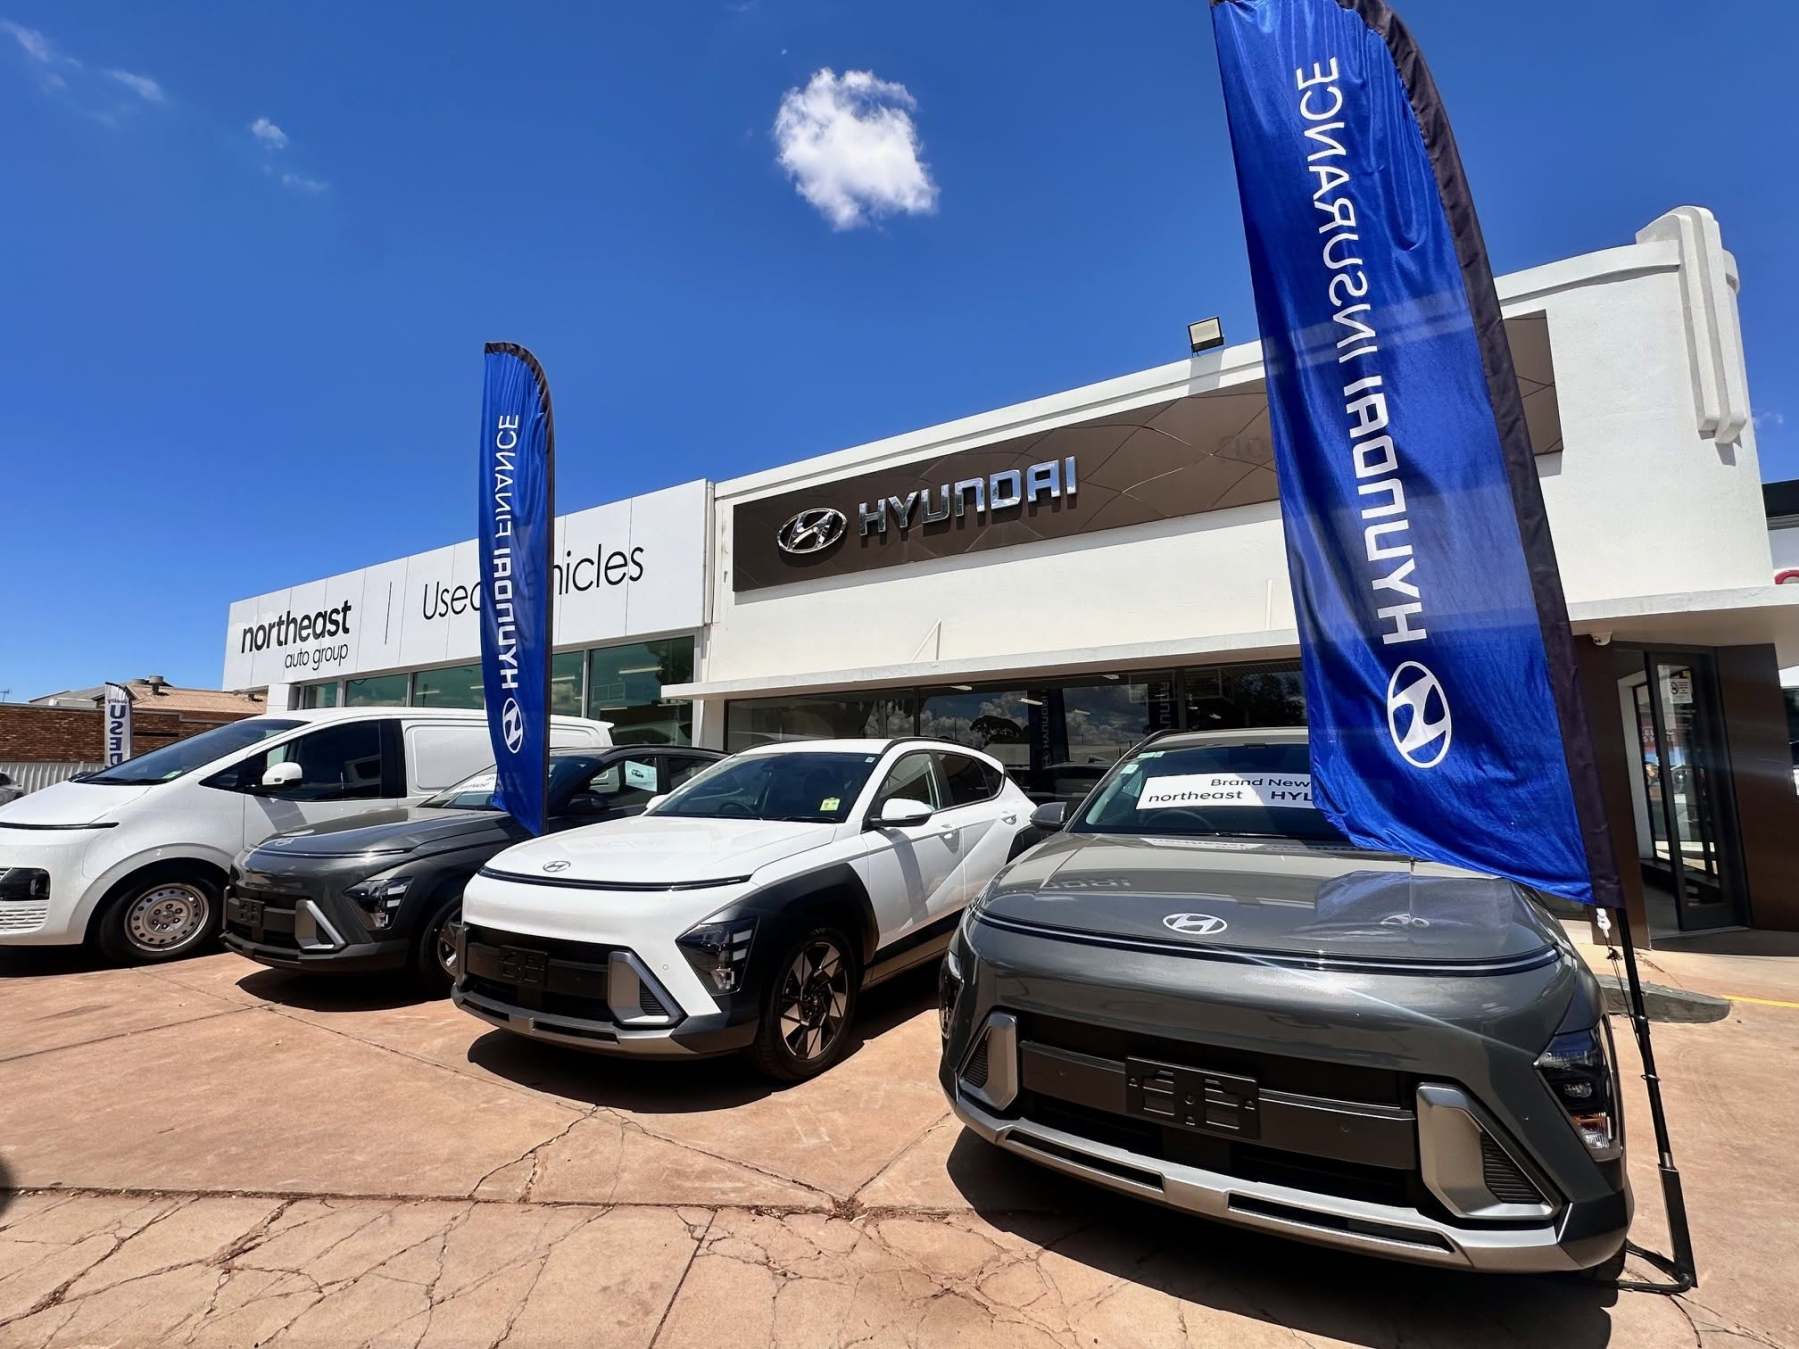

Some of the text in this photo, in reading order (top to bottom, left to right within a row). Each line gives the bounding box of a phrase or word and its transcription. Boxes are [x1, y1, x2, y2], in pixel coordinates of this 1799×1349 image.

[858, 455, 1078, 537] HYUNDAI
[241, 599, 352, 654] northeast
[284, 643, 349, 671] auto group
[1148, 790, 1244, 803] northeast
[1210, 778, 1310, 788] Brand New
